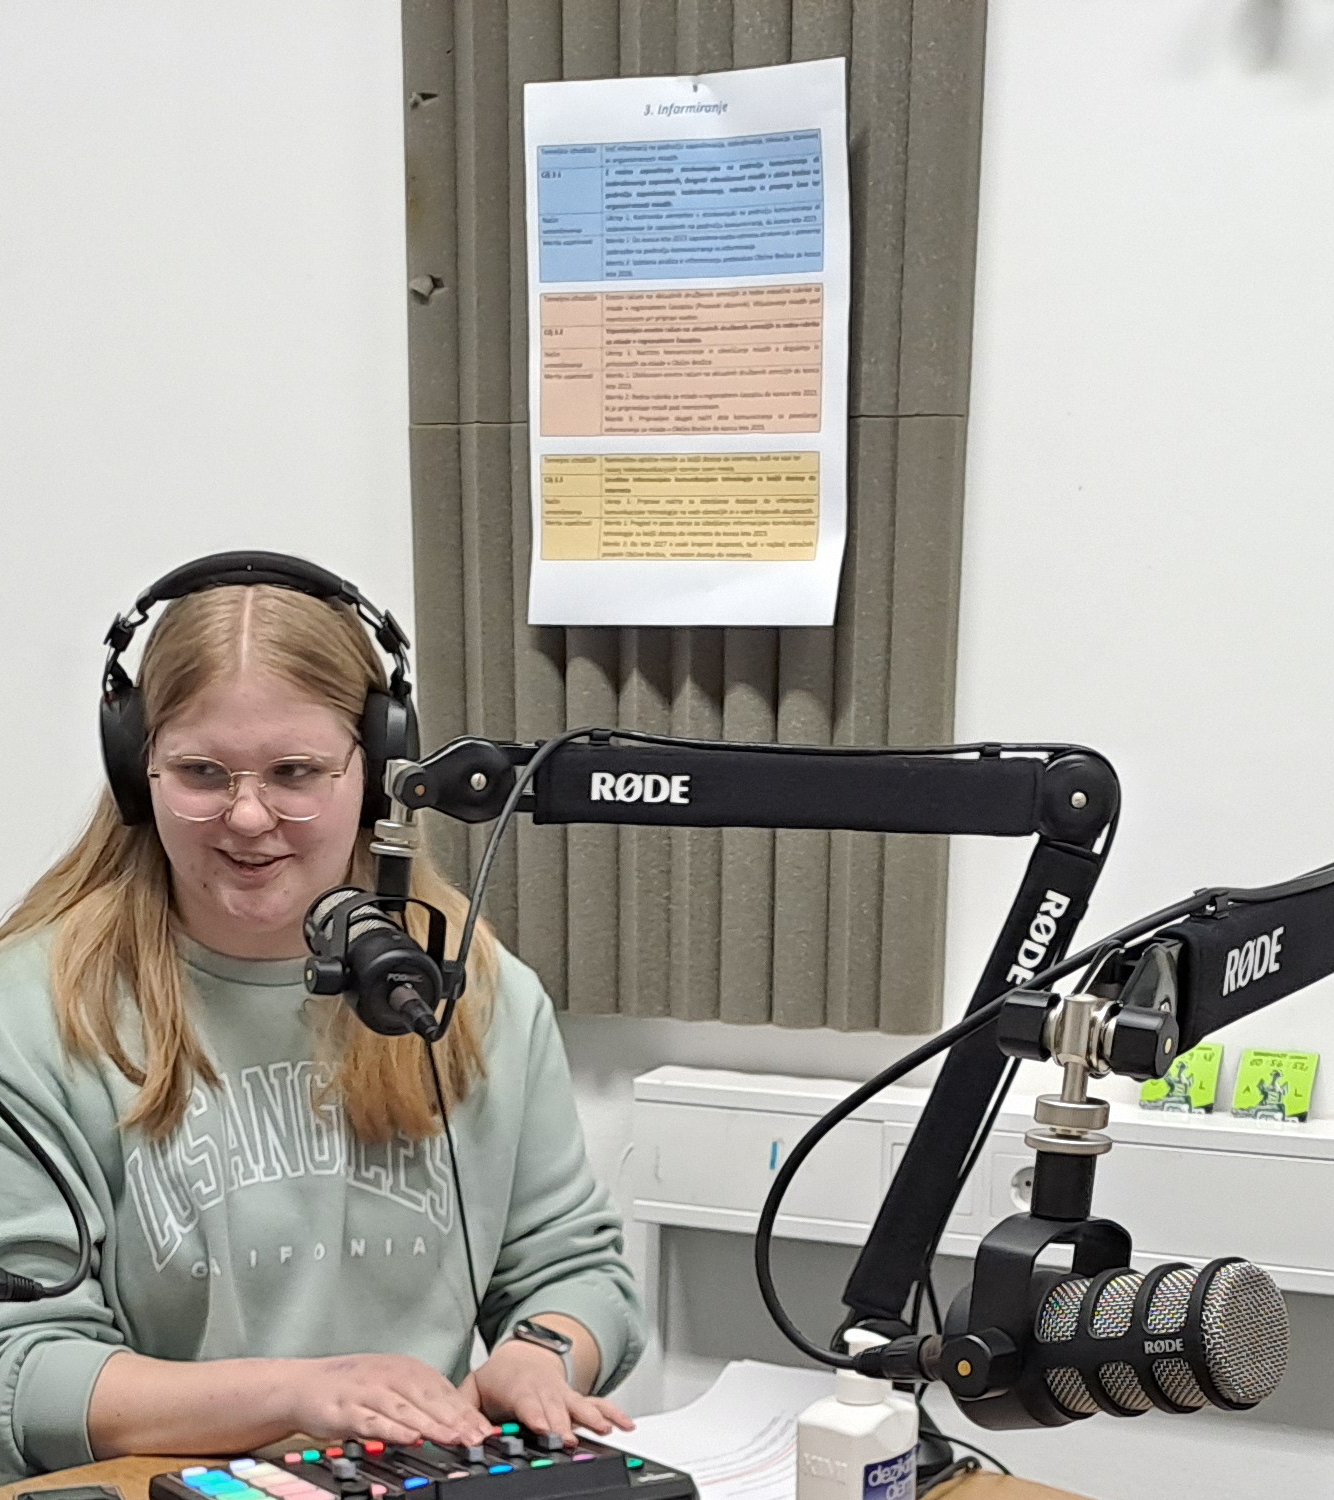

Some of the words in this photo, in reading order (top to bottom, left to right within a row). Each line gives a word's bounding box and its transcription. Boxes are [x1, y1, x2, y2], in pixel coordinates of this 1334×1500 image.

[643, 103, 654, 116] 3.
[657, 100, 729, 117] Informiranje
[590, 772, 691, 806] RØDE
[1005, 890, 1071, 986] RØDE
[1221, 926, 1285, 998] RØDE
[1144, 1338, 1185, 1354] RØDE
